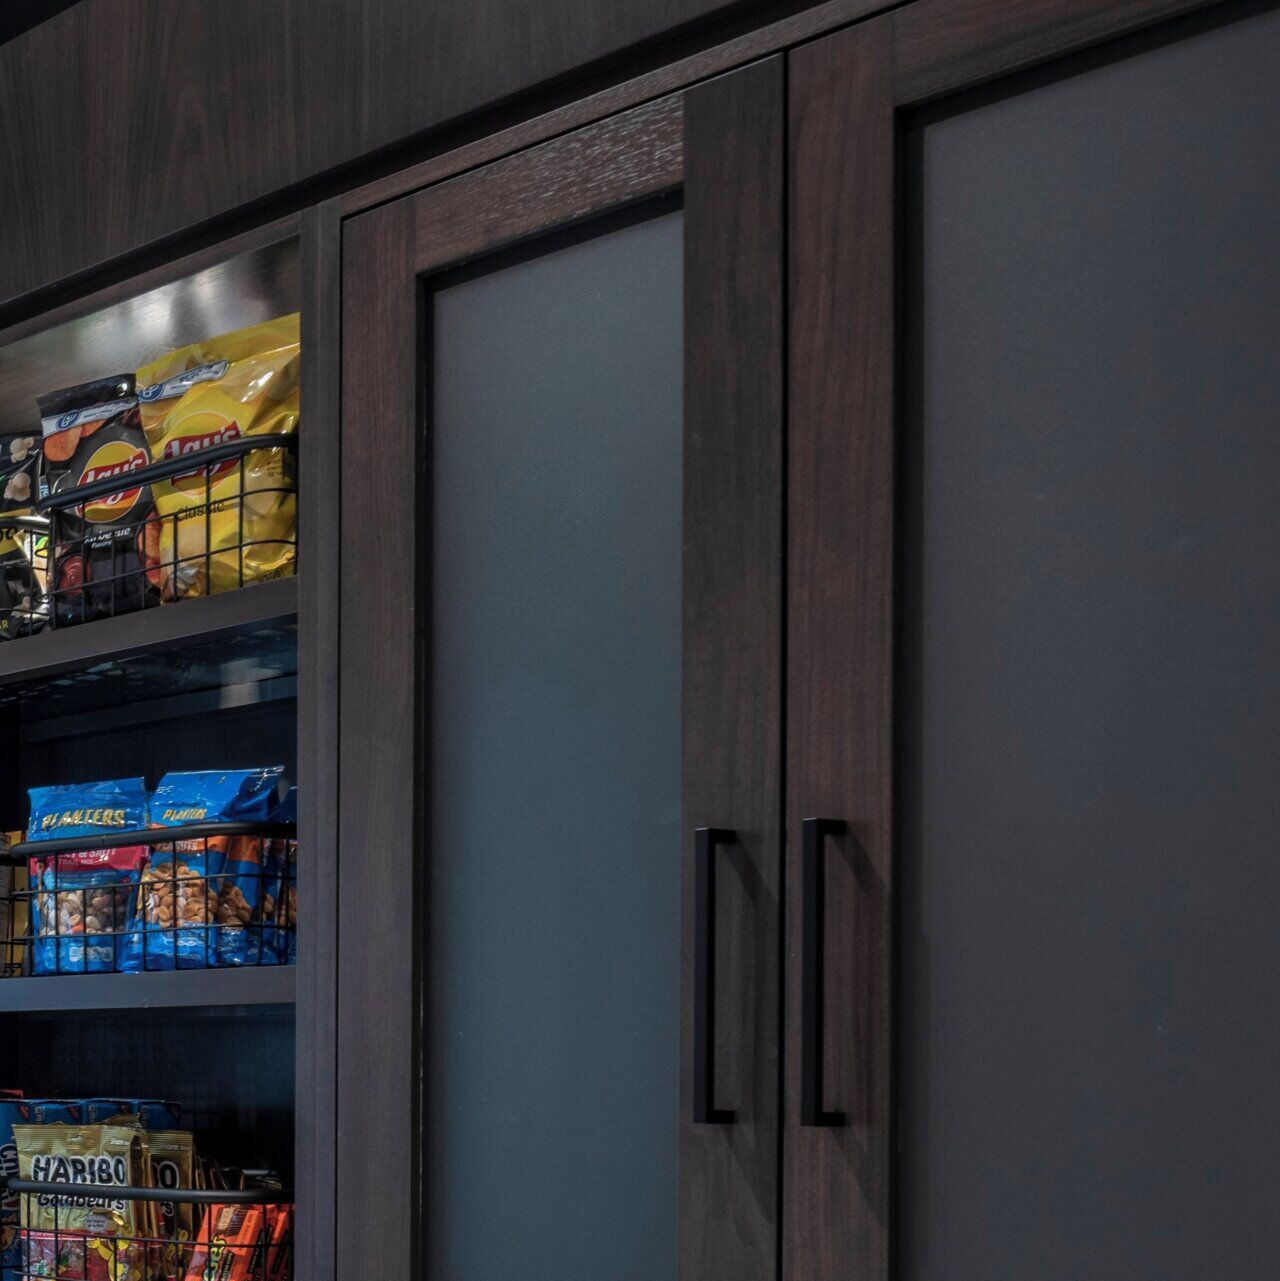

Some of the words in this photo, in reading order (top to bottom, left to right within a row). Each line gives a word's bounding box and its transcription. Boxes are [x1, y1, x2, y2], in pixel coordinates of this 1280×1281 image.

[176, 501, 225, 521] Classic
[42, 809, 125, 828] PLANTERS
[162, 808, 207, 821] PLANTERS
[32, 1156, 128, 1185] HARIBO
